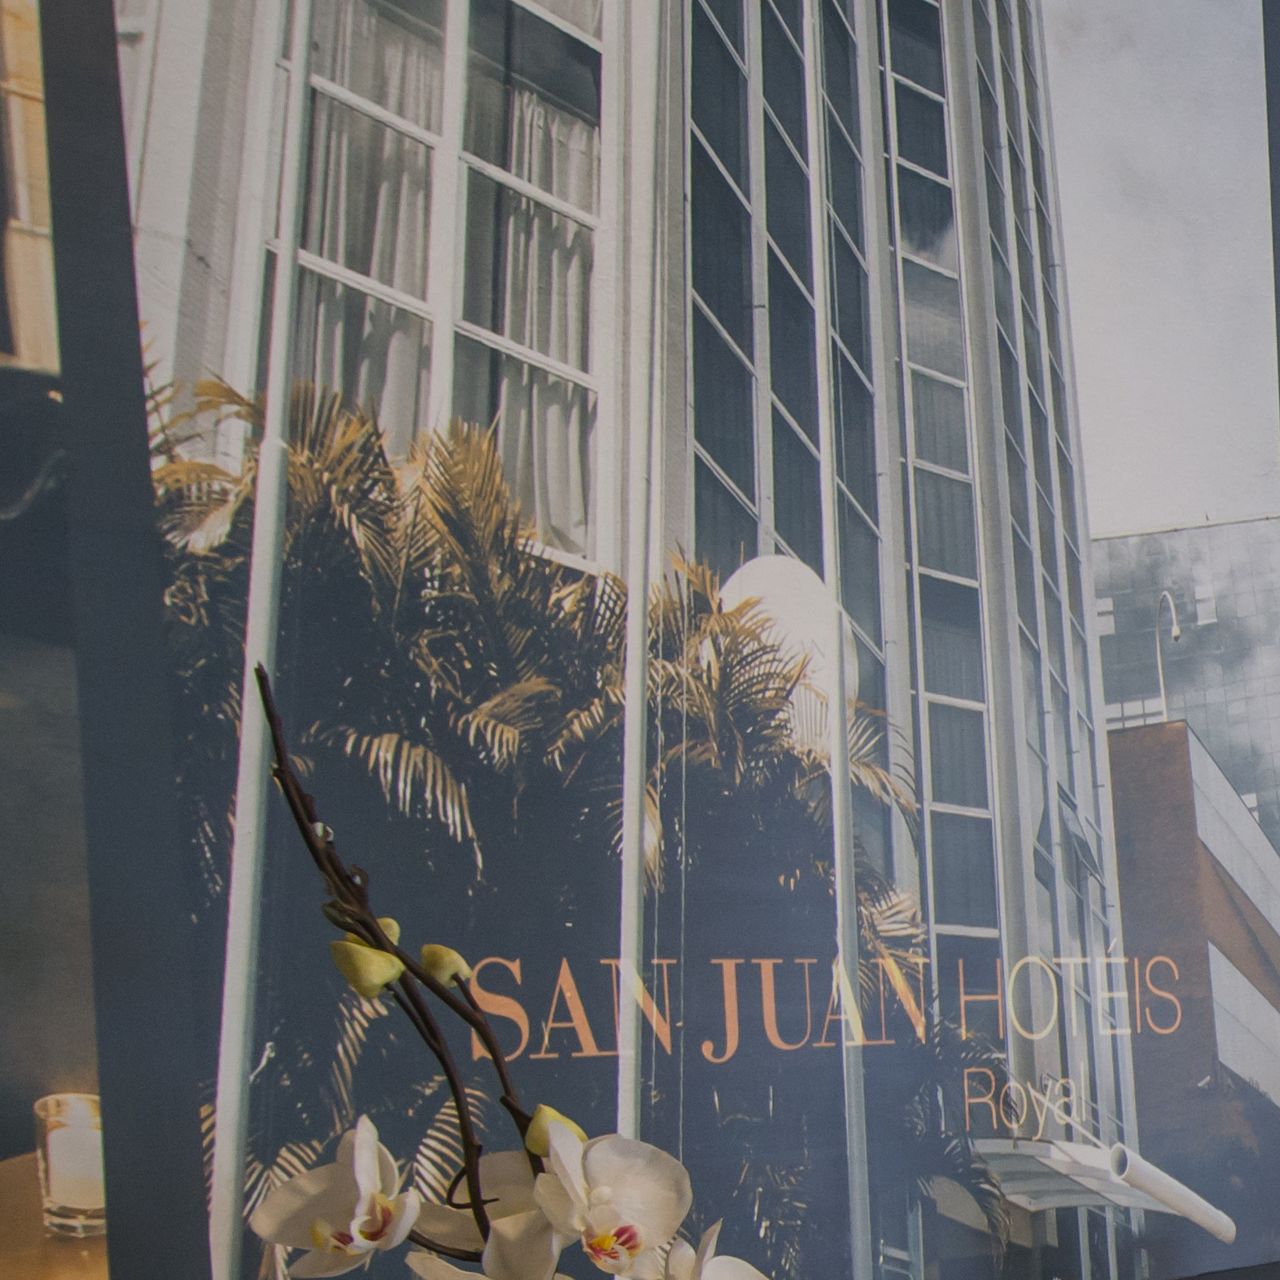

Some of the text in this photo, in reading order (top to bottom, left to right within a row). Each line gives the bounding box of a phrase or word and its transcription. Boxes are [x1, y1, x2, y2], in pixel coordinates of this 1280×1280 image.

[470, 937, 1183, 1064] SAN JUAN HOTÉIS
[962, 1061, 1088, 1140] Royal
